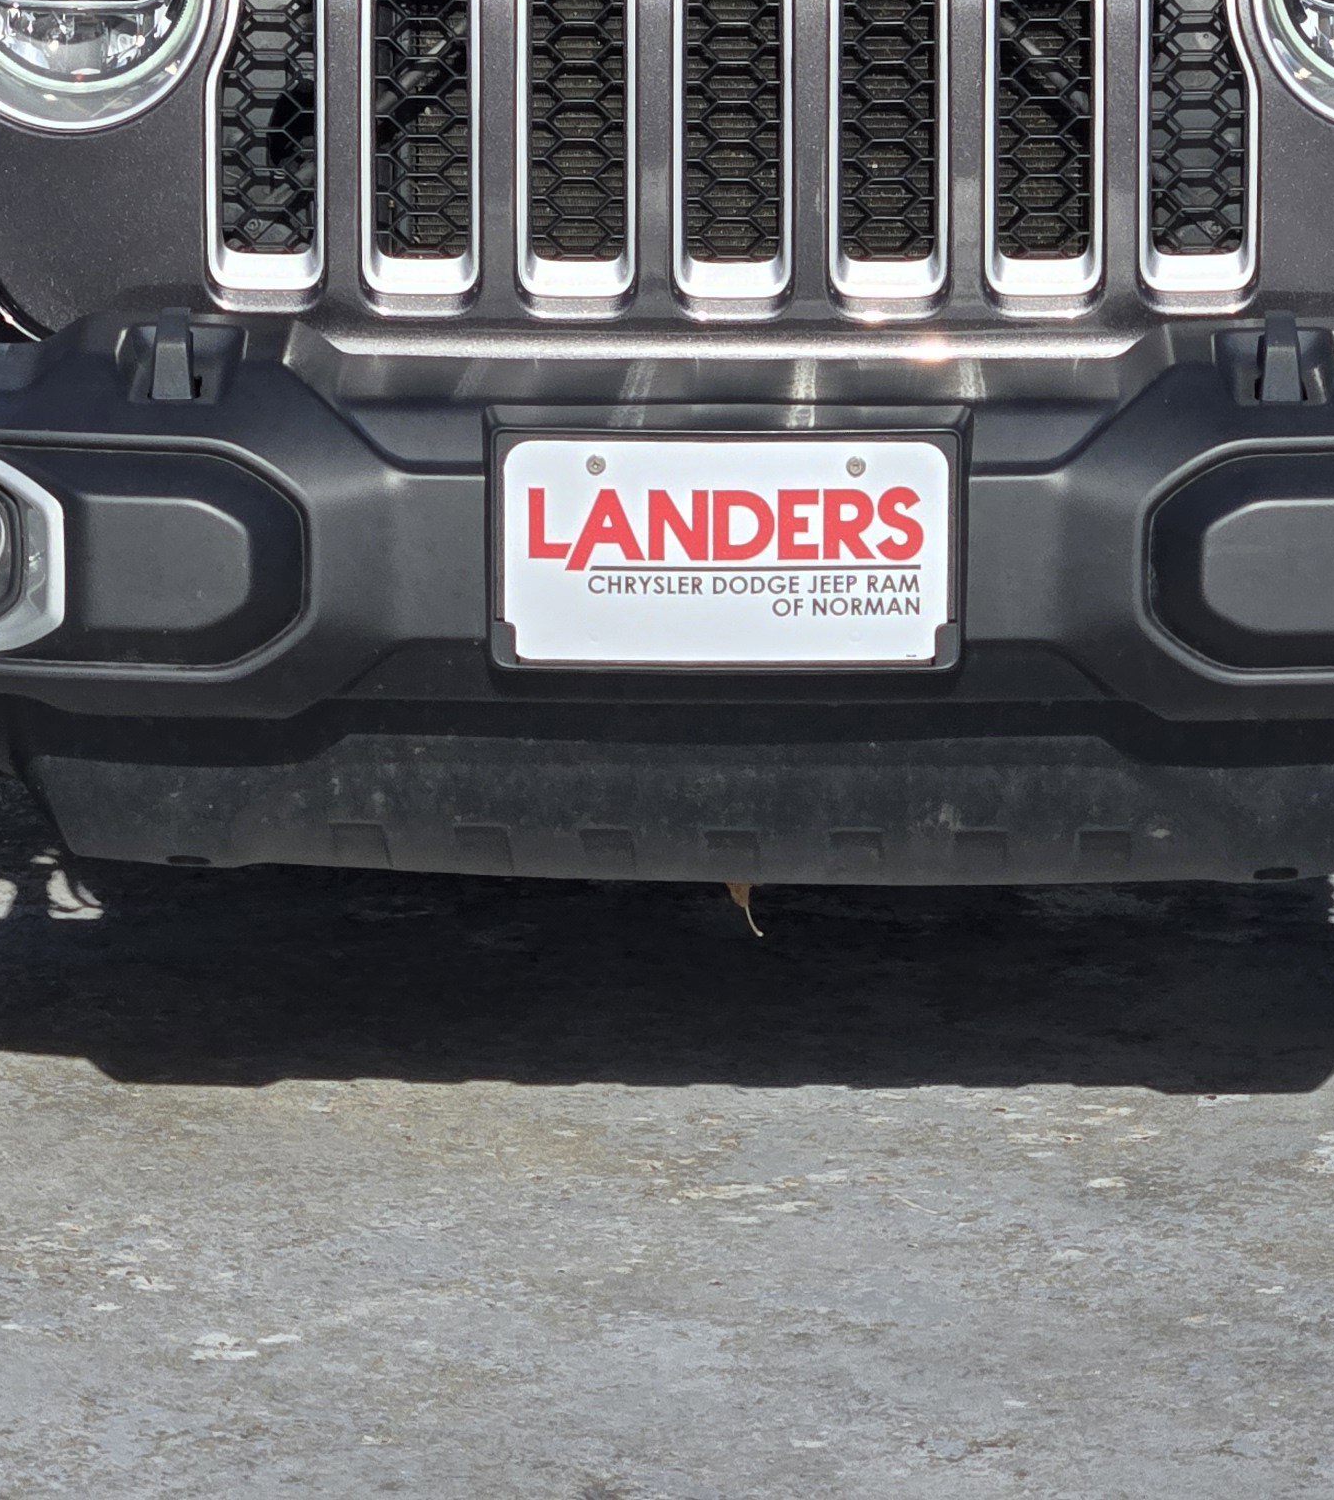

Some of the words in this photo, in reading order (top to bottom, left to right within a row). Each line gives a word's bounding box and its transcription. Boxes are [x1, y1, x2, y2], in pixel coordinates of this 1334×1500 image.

[528, 486, 924, 571] LANDERS
[588, 575, 703, 595] CHRYSLER
[712, 575, 800, 595] DODGE
[807, 575, 857, 594] JEEP
[868, 574, 920, 593] RAM
[772, 598, 805, 617] OF
[812, 597, 920, 616] NORMAN
